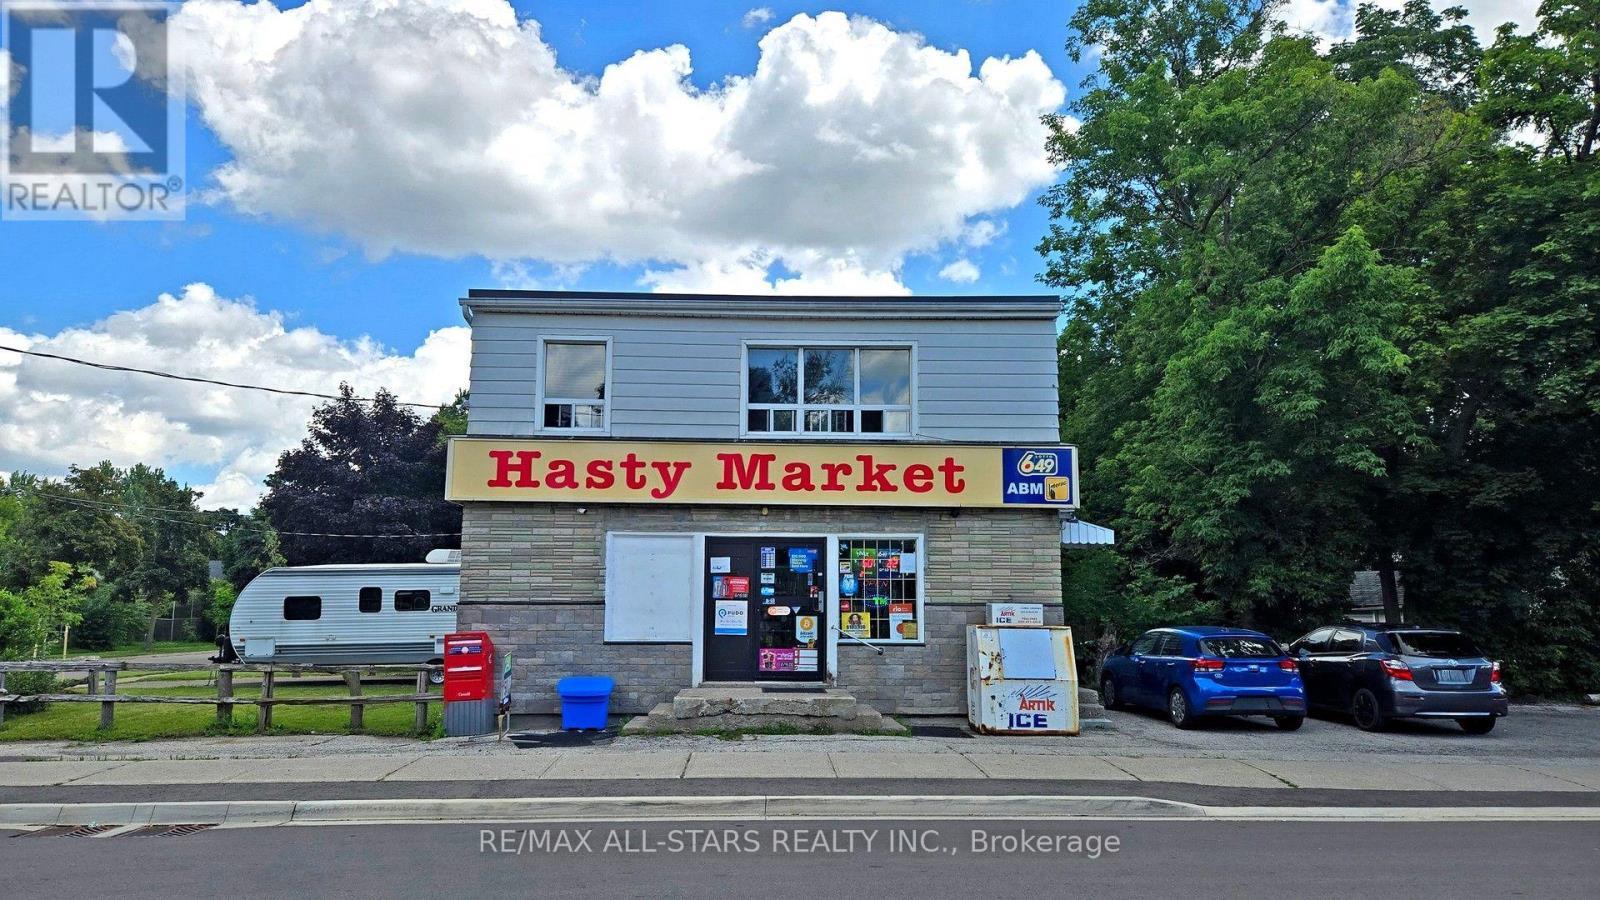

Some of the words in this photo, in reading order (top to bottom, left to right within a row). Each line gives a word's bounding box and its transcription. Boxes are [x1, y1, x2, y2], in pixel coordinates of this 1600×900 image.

[487, 450, 692, 499] Hasty
[716, 453, 966, 494] Market
[1006, 482, 1043, 495] ABM
[1008, 713, 1048, 729] ICE
